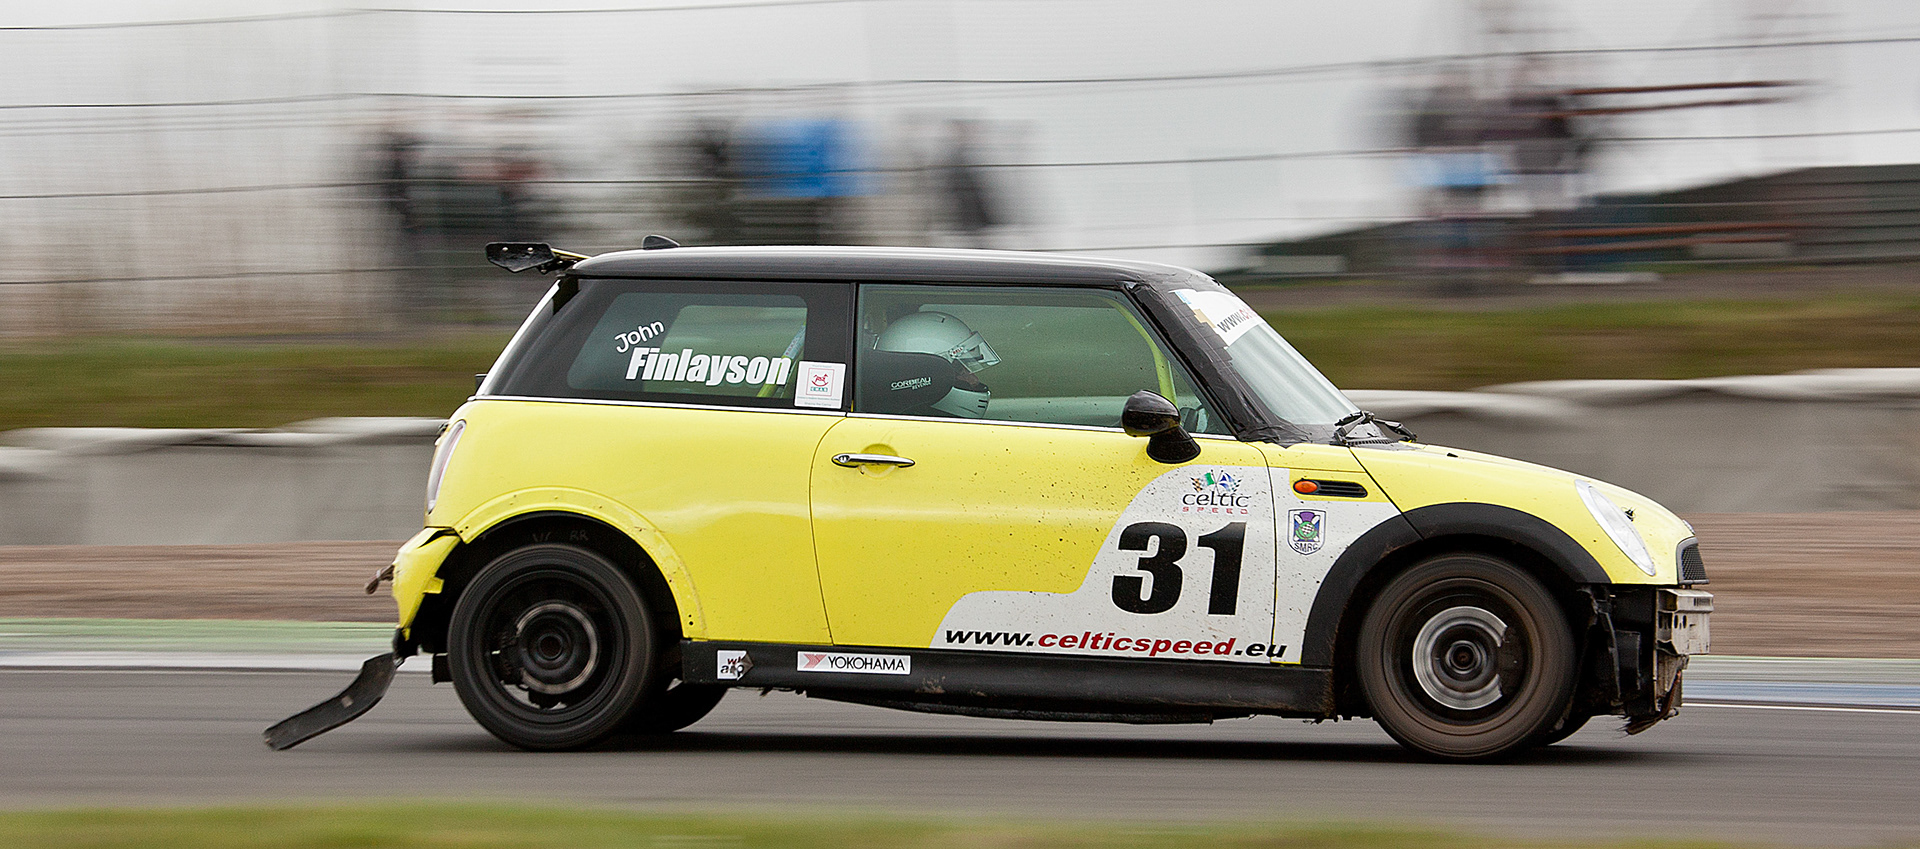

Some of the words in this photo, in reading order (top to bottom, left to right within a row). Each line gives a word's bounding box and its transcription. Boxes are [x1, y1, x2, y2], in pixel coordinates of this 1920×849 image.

[614, 321, 665, 353] John
[625, 347, 793, 386] Finlayson
[890, 376, 932, 389] CORBEAU
[1182, 506, 1249, 515] SPEED
[1294, 542, 1319, 552] SMRC
[1111, 521, 1247, 616] 31
[944, 629, 1288, 659] www.celticspeed.eu
[827, 655, 906, 671] YOKOHAMA
